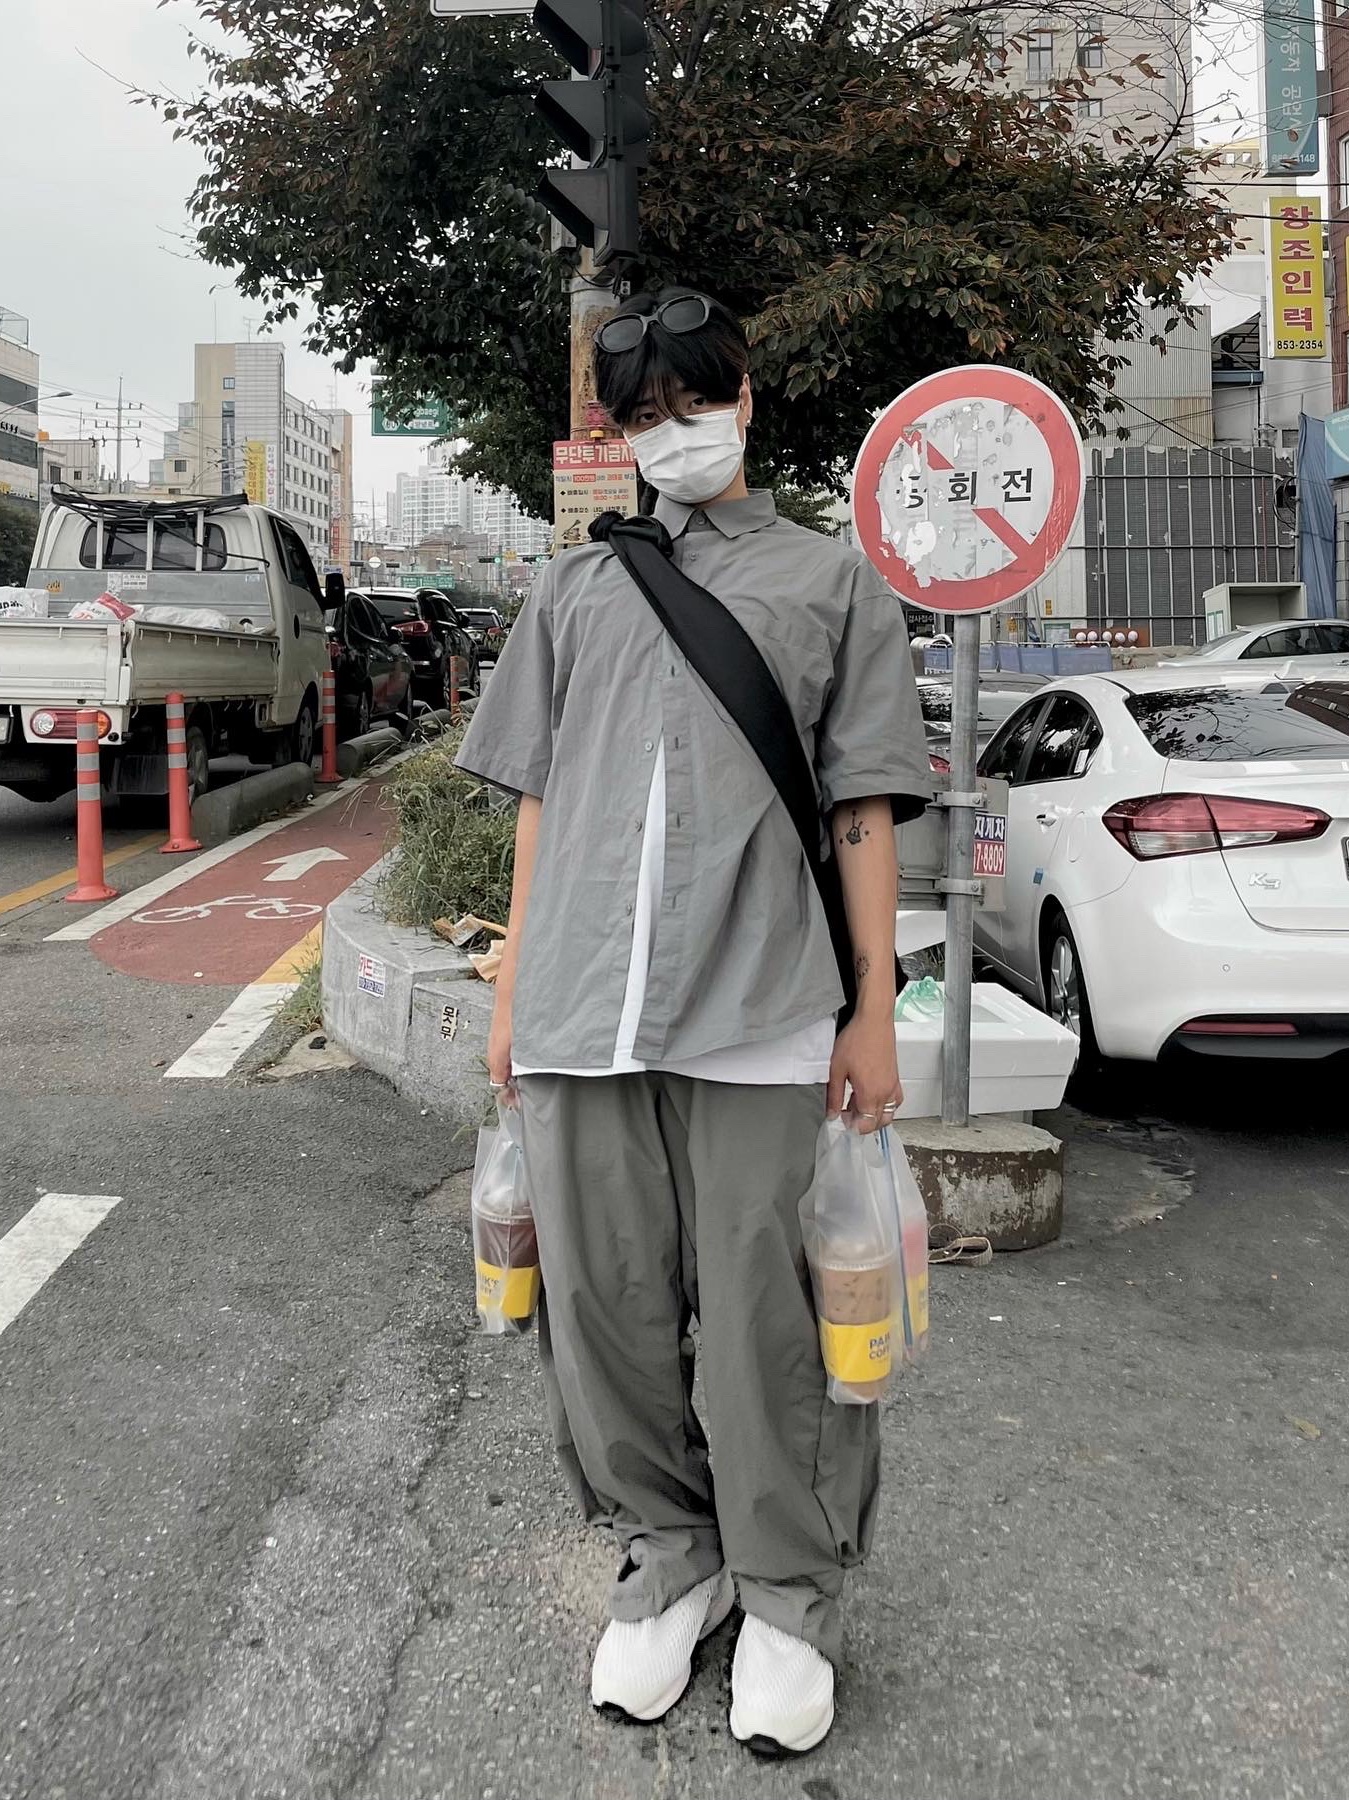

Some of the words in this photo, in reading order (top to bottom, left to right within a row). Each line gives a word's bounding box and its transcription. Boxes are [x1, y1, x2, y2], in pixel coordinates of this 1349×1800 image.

[1279, 206, 1314, 332] 창조인력
[1277, 340, 1323, 350] 853-2354
[974, 843, 1004, 872] 7-8809
